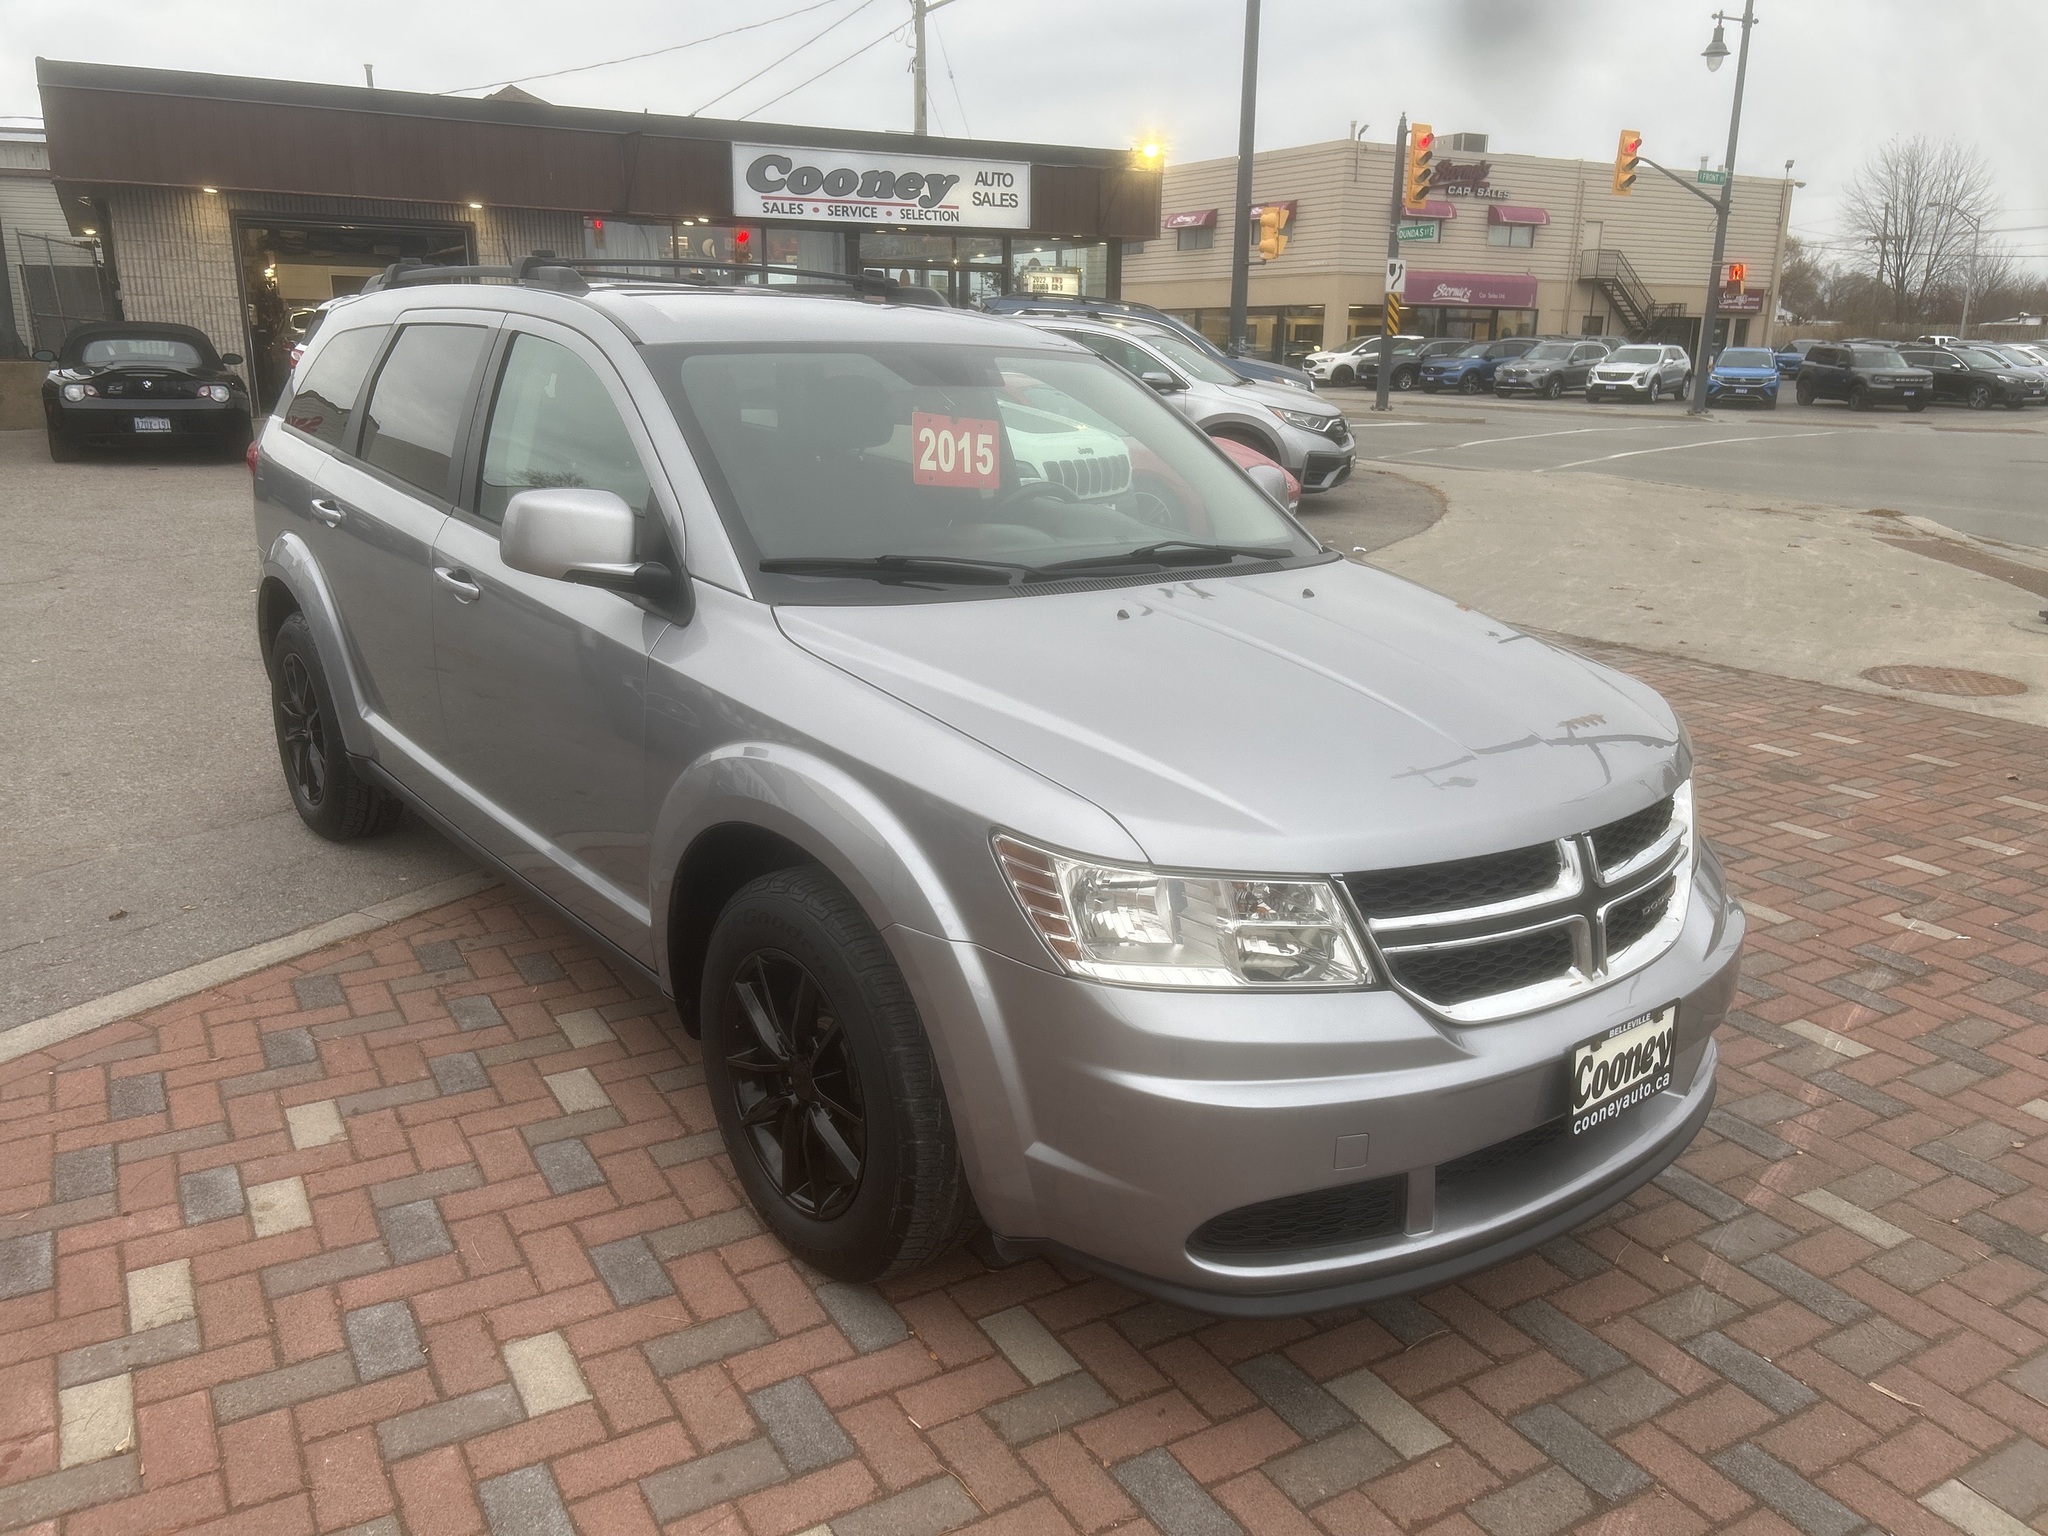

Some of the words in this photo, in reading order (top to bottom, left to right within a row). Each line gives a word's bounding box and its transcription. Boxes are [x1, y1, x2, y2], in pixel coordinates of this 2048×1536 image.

[746, 154, 960, 209] Cooney
[974, 171, 1014, 188] AUTO
[1702, 172, 1719, 183] FRONT
[972, 191, 1019, 209] SALES
[1447, 185, 1471, 196] CAR
[1476, 188, 1511, 199] SALES
[762, 201, 804, 215] SALES
[827, 205, 878, 219] SERVICE
[900, 208, 960, 223] SELECTION
[1398, 227, 1424, 239] DUNDAS
[1432, 283, 1473, 299] Stormy's
[919, 427, 994, 475] 2015
[1609, 1012, 1651, 1038] BELLEVILLE
[1573, 1027, 1673, 1110] Cooney
[1573, 1072, 1670, 1135] cooneyauto.ca
